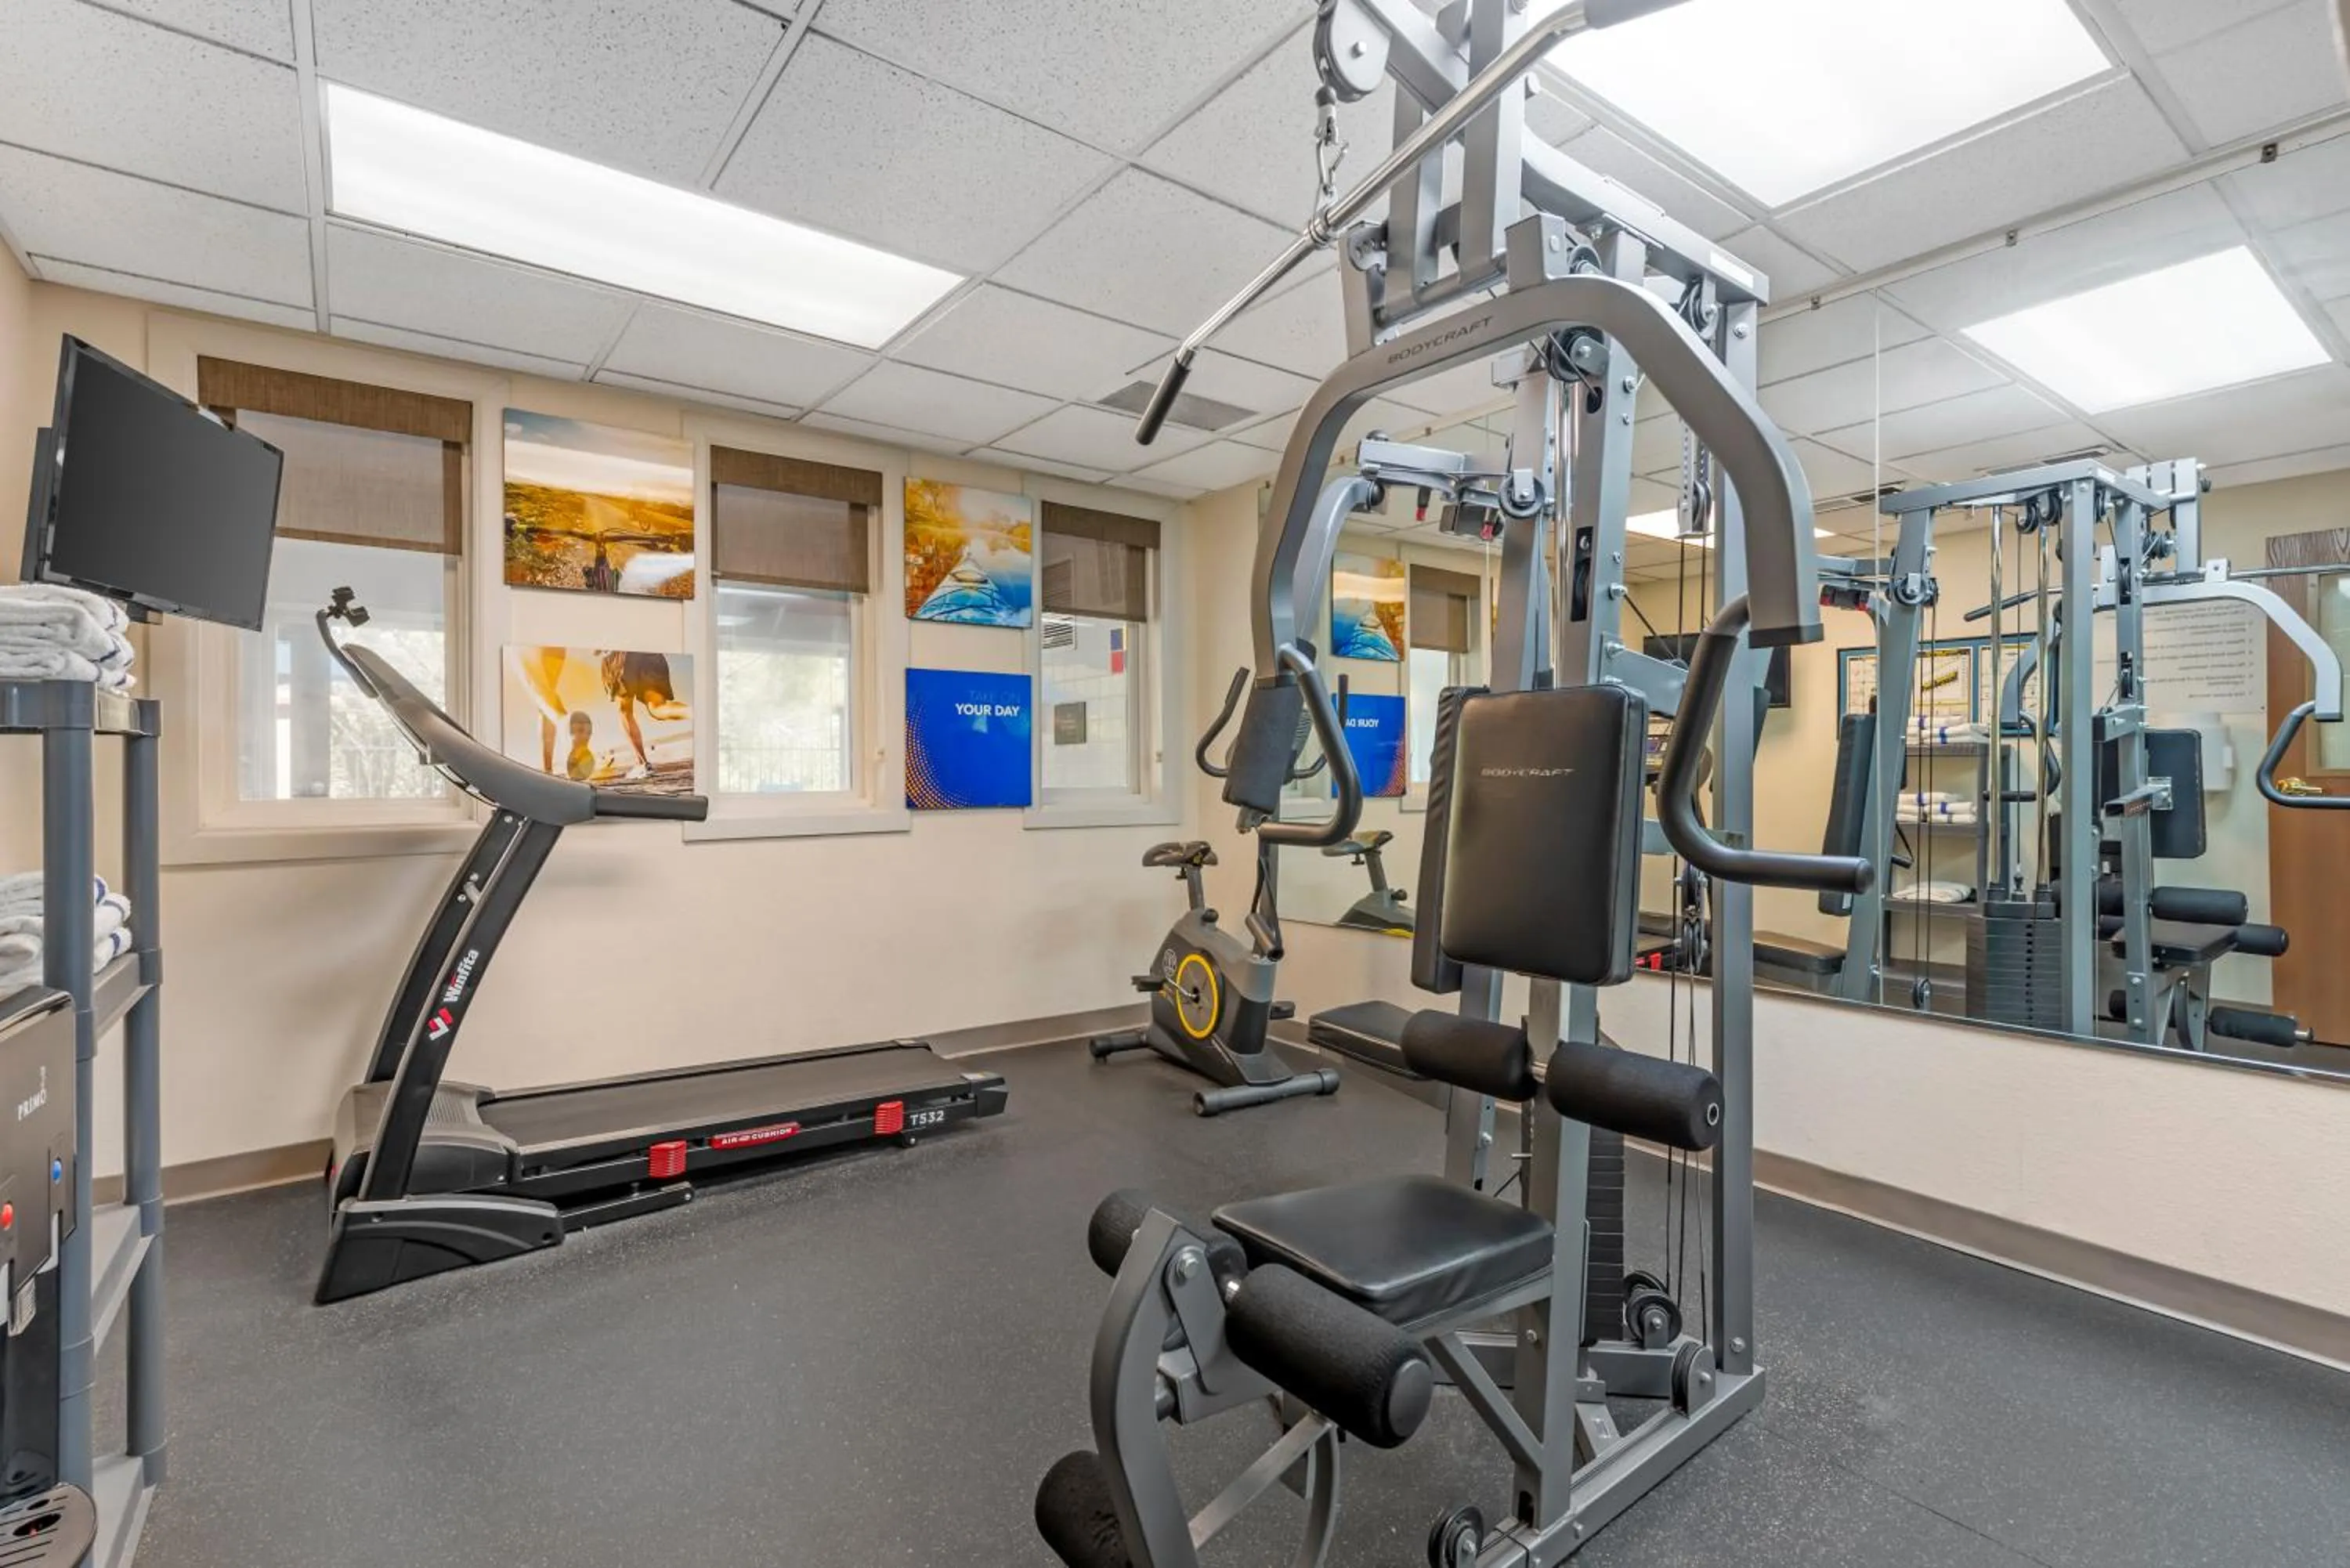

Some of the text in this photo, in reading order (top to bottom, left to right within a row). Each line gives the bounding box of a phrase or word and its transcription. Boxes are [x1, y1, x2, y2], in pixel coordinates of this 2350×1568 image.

[1387, 315, 1494, 364] BODYCRAFT
[955, 703, 1021, 717] YOUR DAY
[1480, 768, 1575, 777] BODYCRAFT
[443, 949, 479, 1002] Winfita
[18, 1089, 47, 1121] PRIMO
[909, 1110, 945, 1125] T532
[721, 1128, 792, 1145] AIR CUSHION
